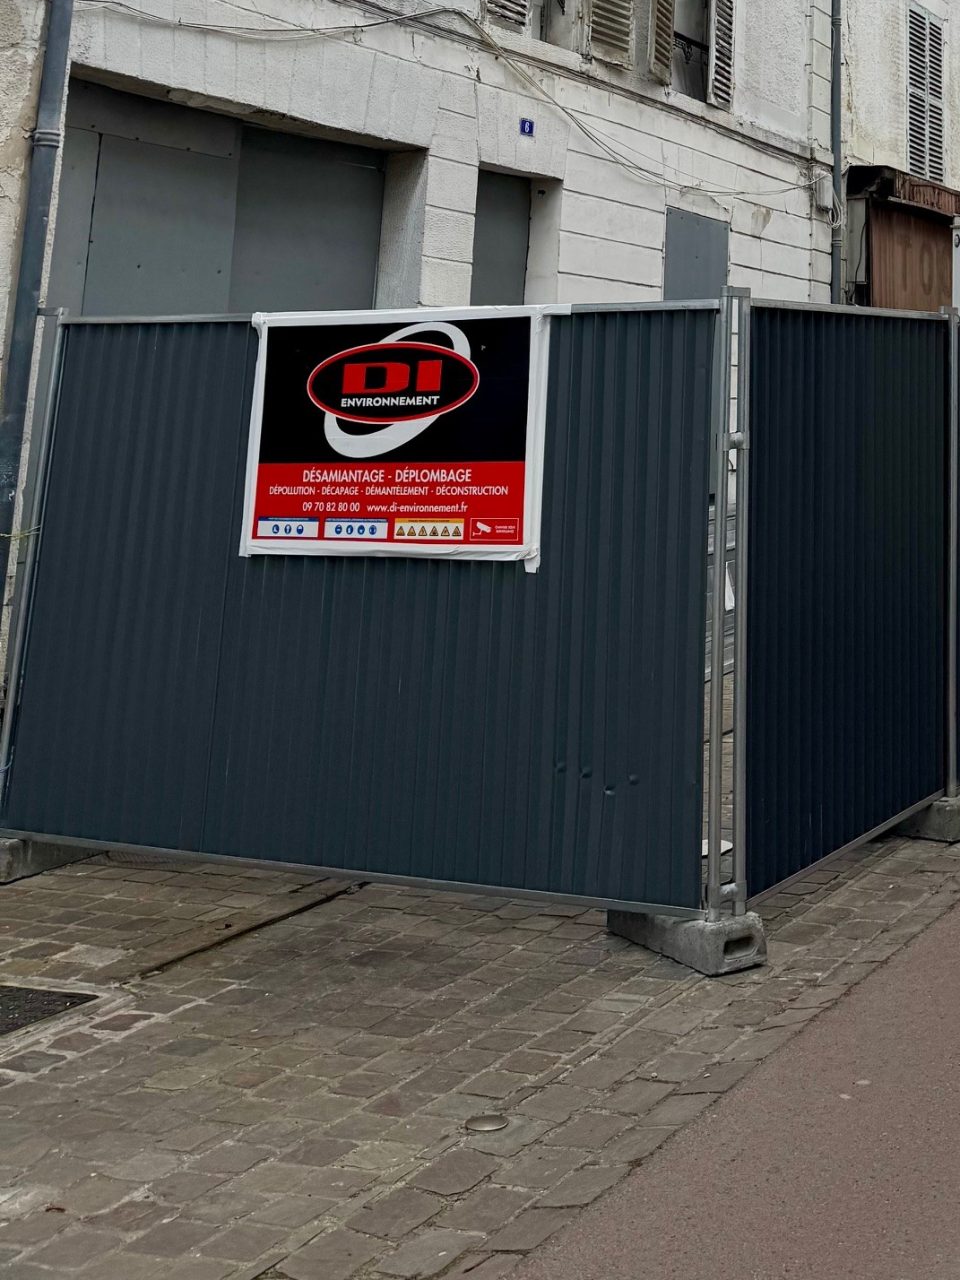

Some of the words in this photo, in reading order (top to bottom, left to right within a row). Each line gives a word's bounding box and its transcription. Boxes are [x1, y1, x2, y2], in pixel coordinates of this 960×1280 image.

[341, 360, 443, 394] DI
[340, 395, 440, 408] ENVIRONNEMENT
[302, 467, 385, 483] DÉSAMIANTAGE
[395, 466, 472, 483] DÉPLOMBAGE
[269, 484, 316, 495] DÉPOLLUTION
[321, 484, 359, 496] DÉCAPAGE
[436, 484, 509, 496] DÉCONSTRUCTION
[302, 502, 313, 512] 09
[314, 502, 325, 512] 70
[326, 502, 336, 512] 82
[338, 502, 348, 512] 80
[350, 502, 360, 512] 00
[367, 502, 469, 513] www.di-environnement.fr
